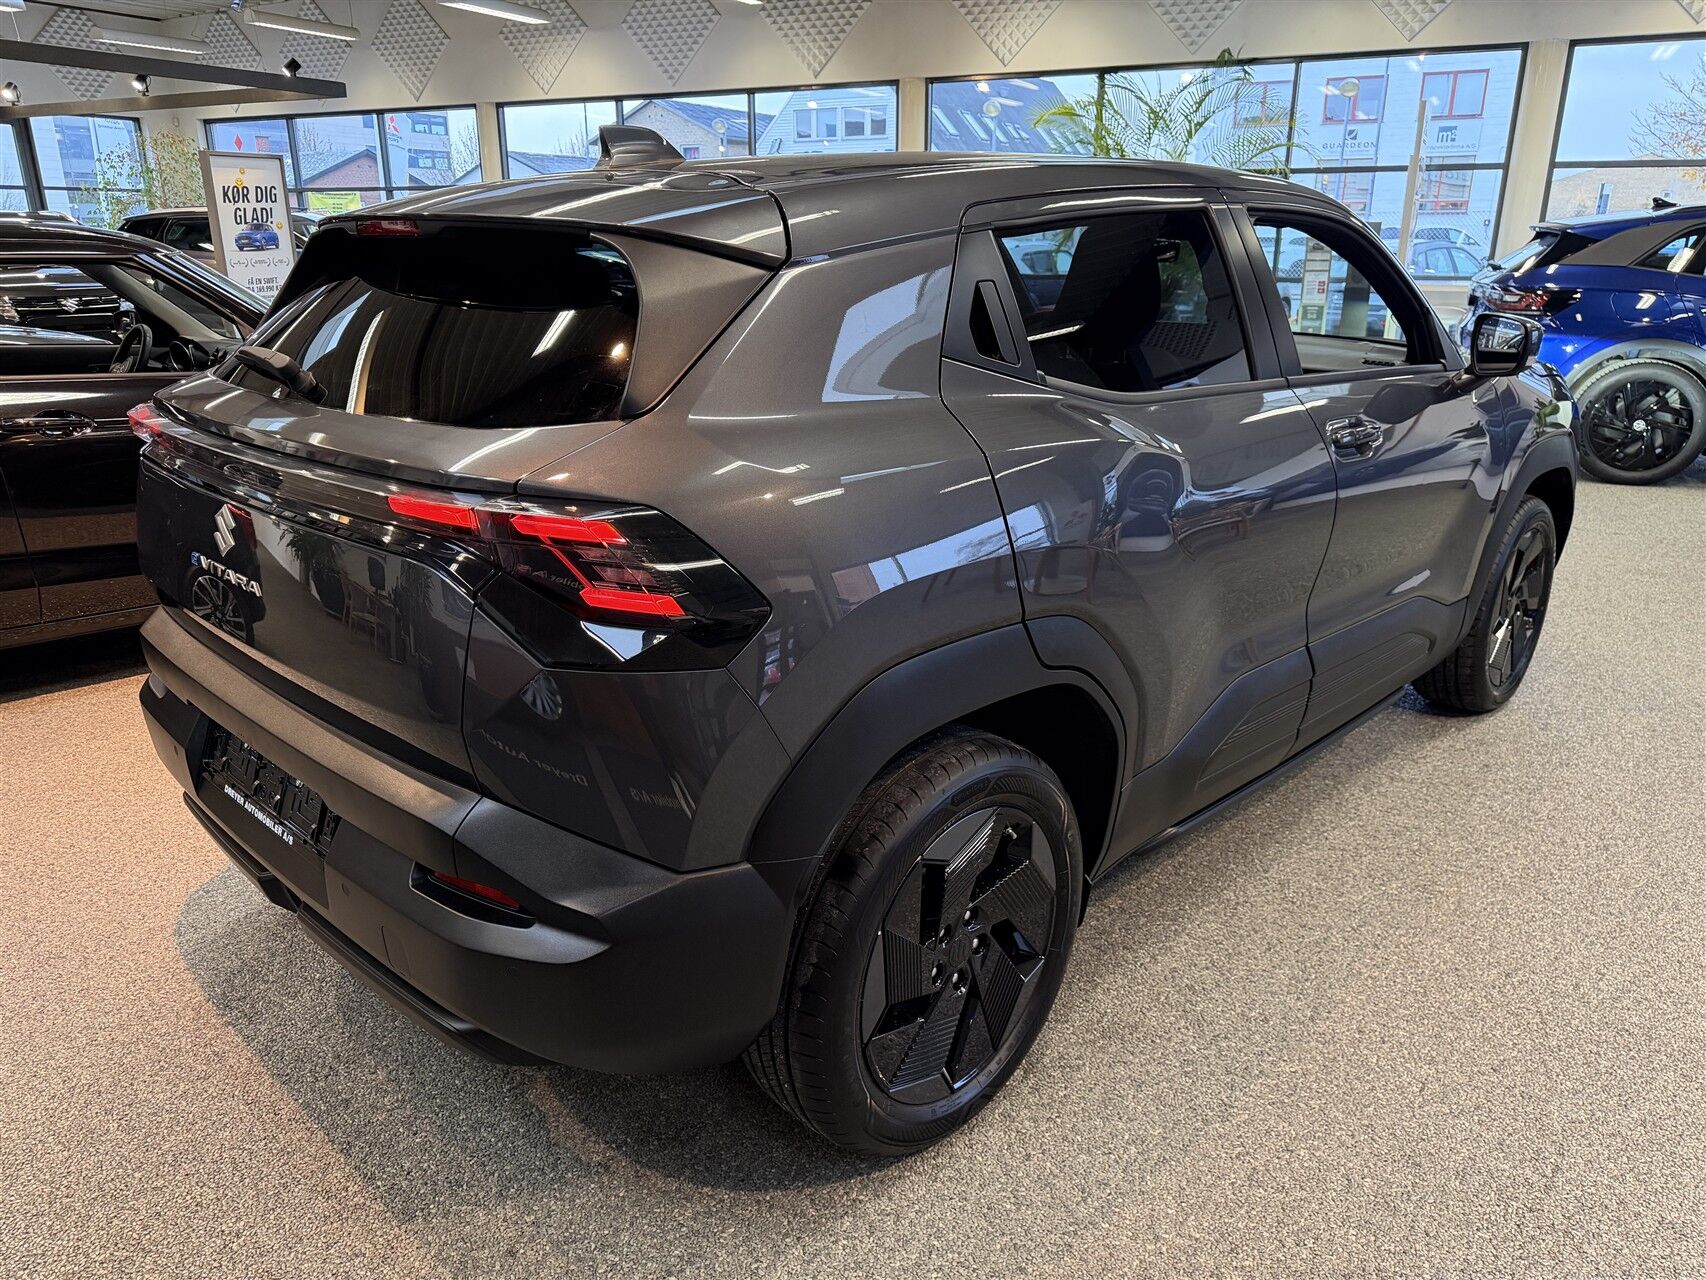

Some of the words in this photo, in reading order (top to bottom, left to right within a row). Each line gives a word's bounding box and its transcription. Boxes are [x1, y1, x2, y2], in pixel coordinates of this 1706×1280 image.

[222, 185, 250, 205] KØR
[255, 185, 277, 203] DIG
[234, 207, 274, 225] GLAD!
[255, 277, 263, 285] EN
[199, 555, 263, 598] VITARA
[224, 784, 245, 807] DREYER
[244, 801, 282, 837] AUTOMOBILER
[282, 831, 294, 846] A/S
